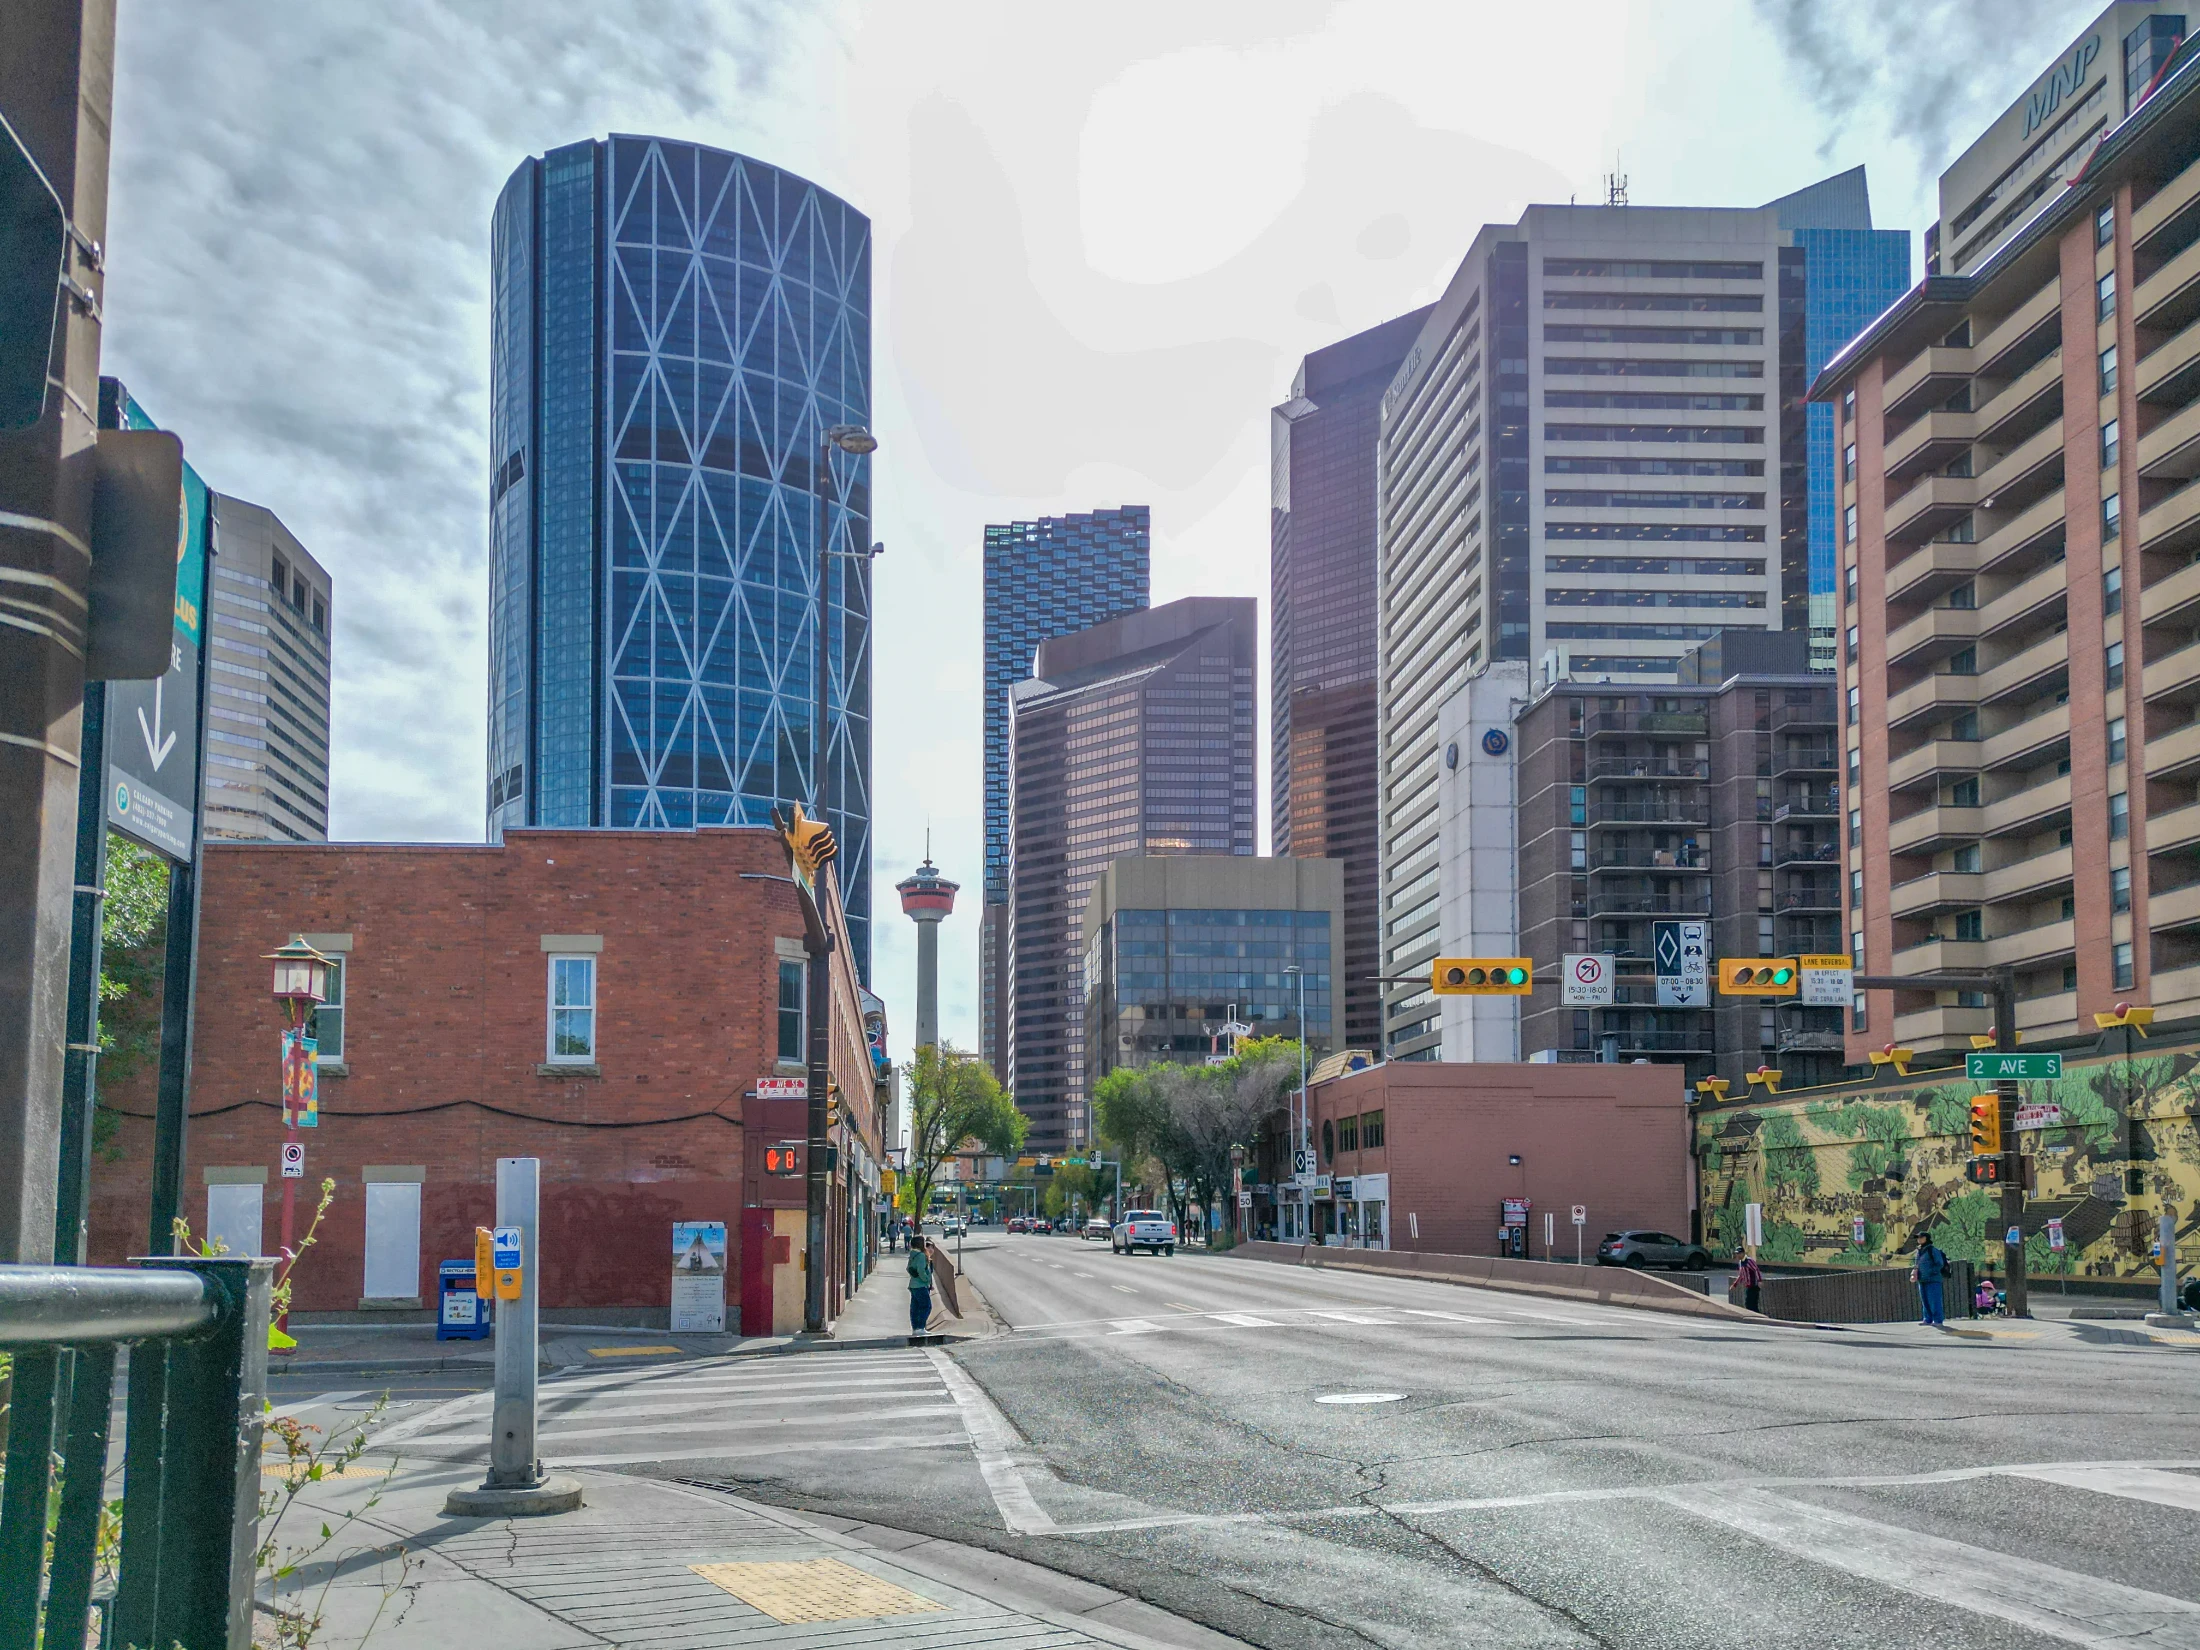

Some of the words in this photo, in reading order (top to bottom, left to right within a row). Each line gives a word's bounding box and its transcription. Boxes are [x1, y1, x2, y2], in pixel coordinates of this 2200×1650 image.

[2022, 34, 2100, 141] MNP
[133, 789, 154, 808] CALGARY
[154, 801, 173, 820] PARKING
[1803, 958, 1818, 966] LANE
[1820, 958, 1849, 966] REVERSAL
[1661, 977, 1679, 985] 07:00
[1973, 1060, 1984, 1075] 2
[1999, 1059, 2028, 1074] AVE
[2046, 1060, 2057, 1074] S
[764, 1080, 770, 1088] 2
[776, 1080, 786, 1088] AVE
[791, 1080, 799, 1088] SE
[785, 1151, 794, 1169] 8
[1240, 1197, 1251, 1206] 50
